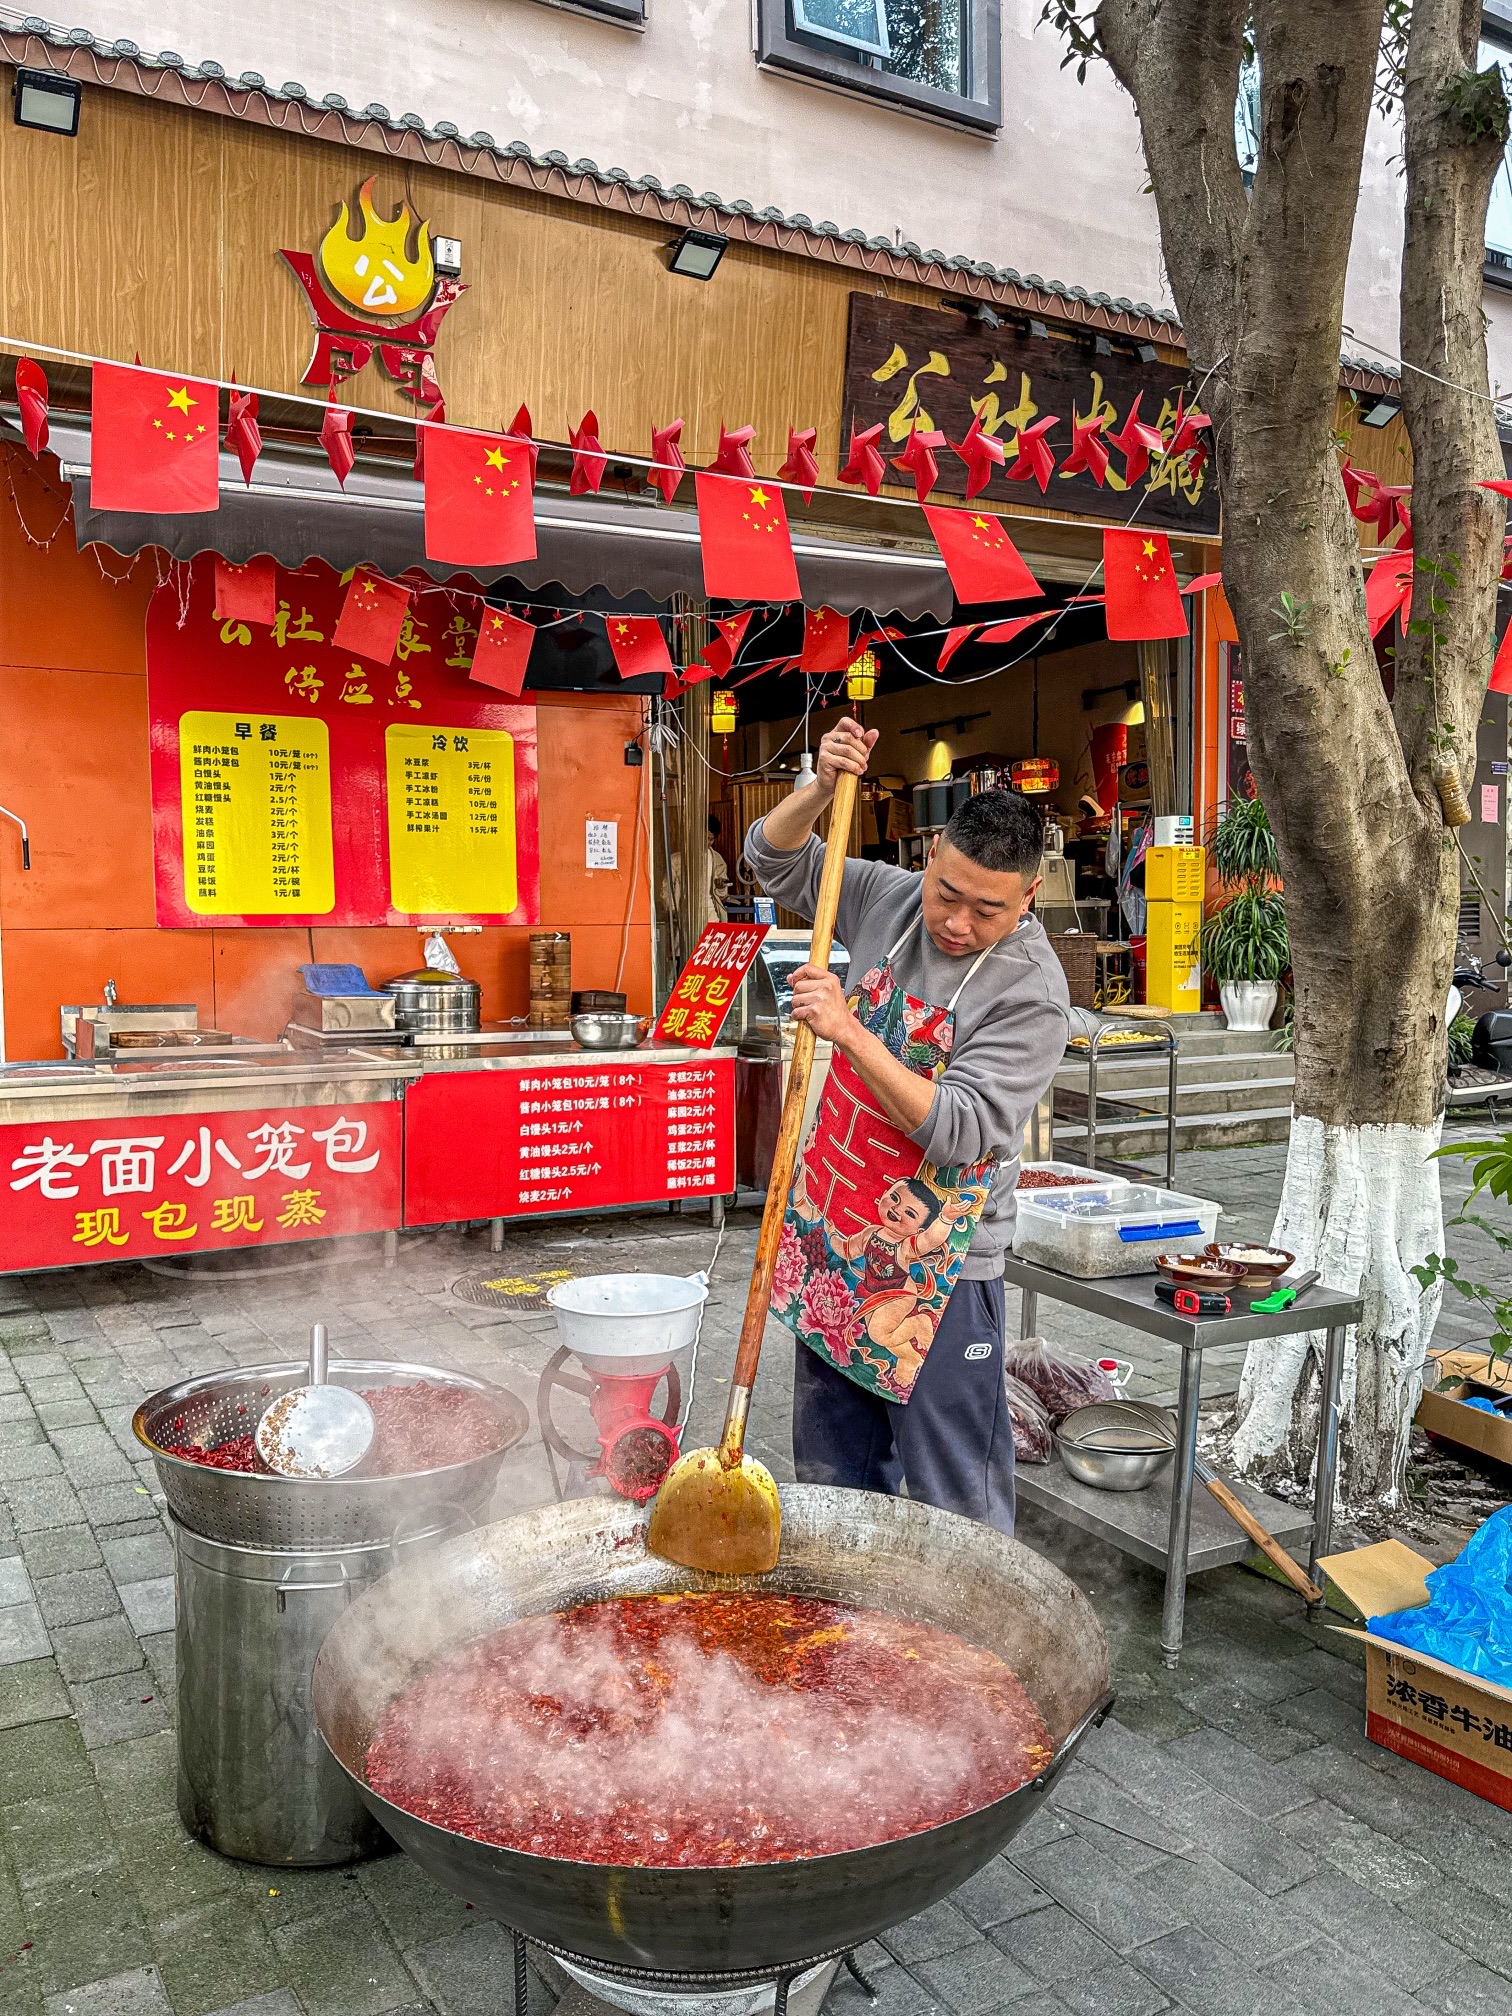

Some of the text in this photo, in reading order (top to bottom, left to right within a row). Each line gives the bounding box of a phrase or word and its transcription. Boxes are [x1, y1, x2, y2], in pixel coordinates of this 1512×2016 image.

[354, 254, 404, 306] 公
[234, 722, 277, 741] 早餐
[432, 735, 468, 752] 冷饮
[193, 745, 239, 756] 鲜肉小笼包
[405, 758, 491, 770] 冰豆浆 3元/杯
[194, 769, 296, 781] 白馒头 1元/个
[468, 775, 491, 783] 6元/份
[270, 784, 296, 793] 2元/个
[406, 785, 492, 796] 手工冰粉 8元/份
[270, 796, 297, 804] 2.5/个
[469, 801, 497, 809] 10元/份
[271, 808, 297, 816] 2元/个
[470, 814, 497, 822] 12元/份
[271, 819, 298, 828] 2元/个
[196, 829, 298, 839] 油条 3元/个
[272, 842, 298, 851] 2元/个
[197, 853, 299, 862] 鸡蛋 2元/个
[198, 865, 300, 874] 豆浆 2元/杯
[678, 974, 730, 1006] 现包
[662, 1008, 716, 1041] 现蒸
[667, 1087, 715, 1101] 油条3元/个
[519, 1120, 583, 1136] 白馒头1元/个
[667, 1121, 715, 1136] 鸡蛋2元/个
[519, 1141, 593, 1159] 黄油馒头2元/个
[667, 1139, 715, 1154] 豆浆2元/杯
[9, 1116, 381, 1200] 老面小笼包
[519, 1162, 601, 1181] 红糖馒头2.5元/个
[72, 1188, 327, 1246] 现包现蒸
[1386, 1674, 1512, 1753] 浓香牛油
